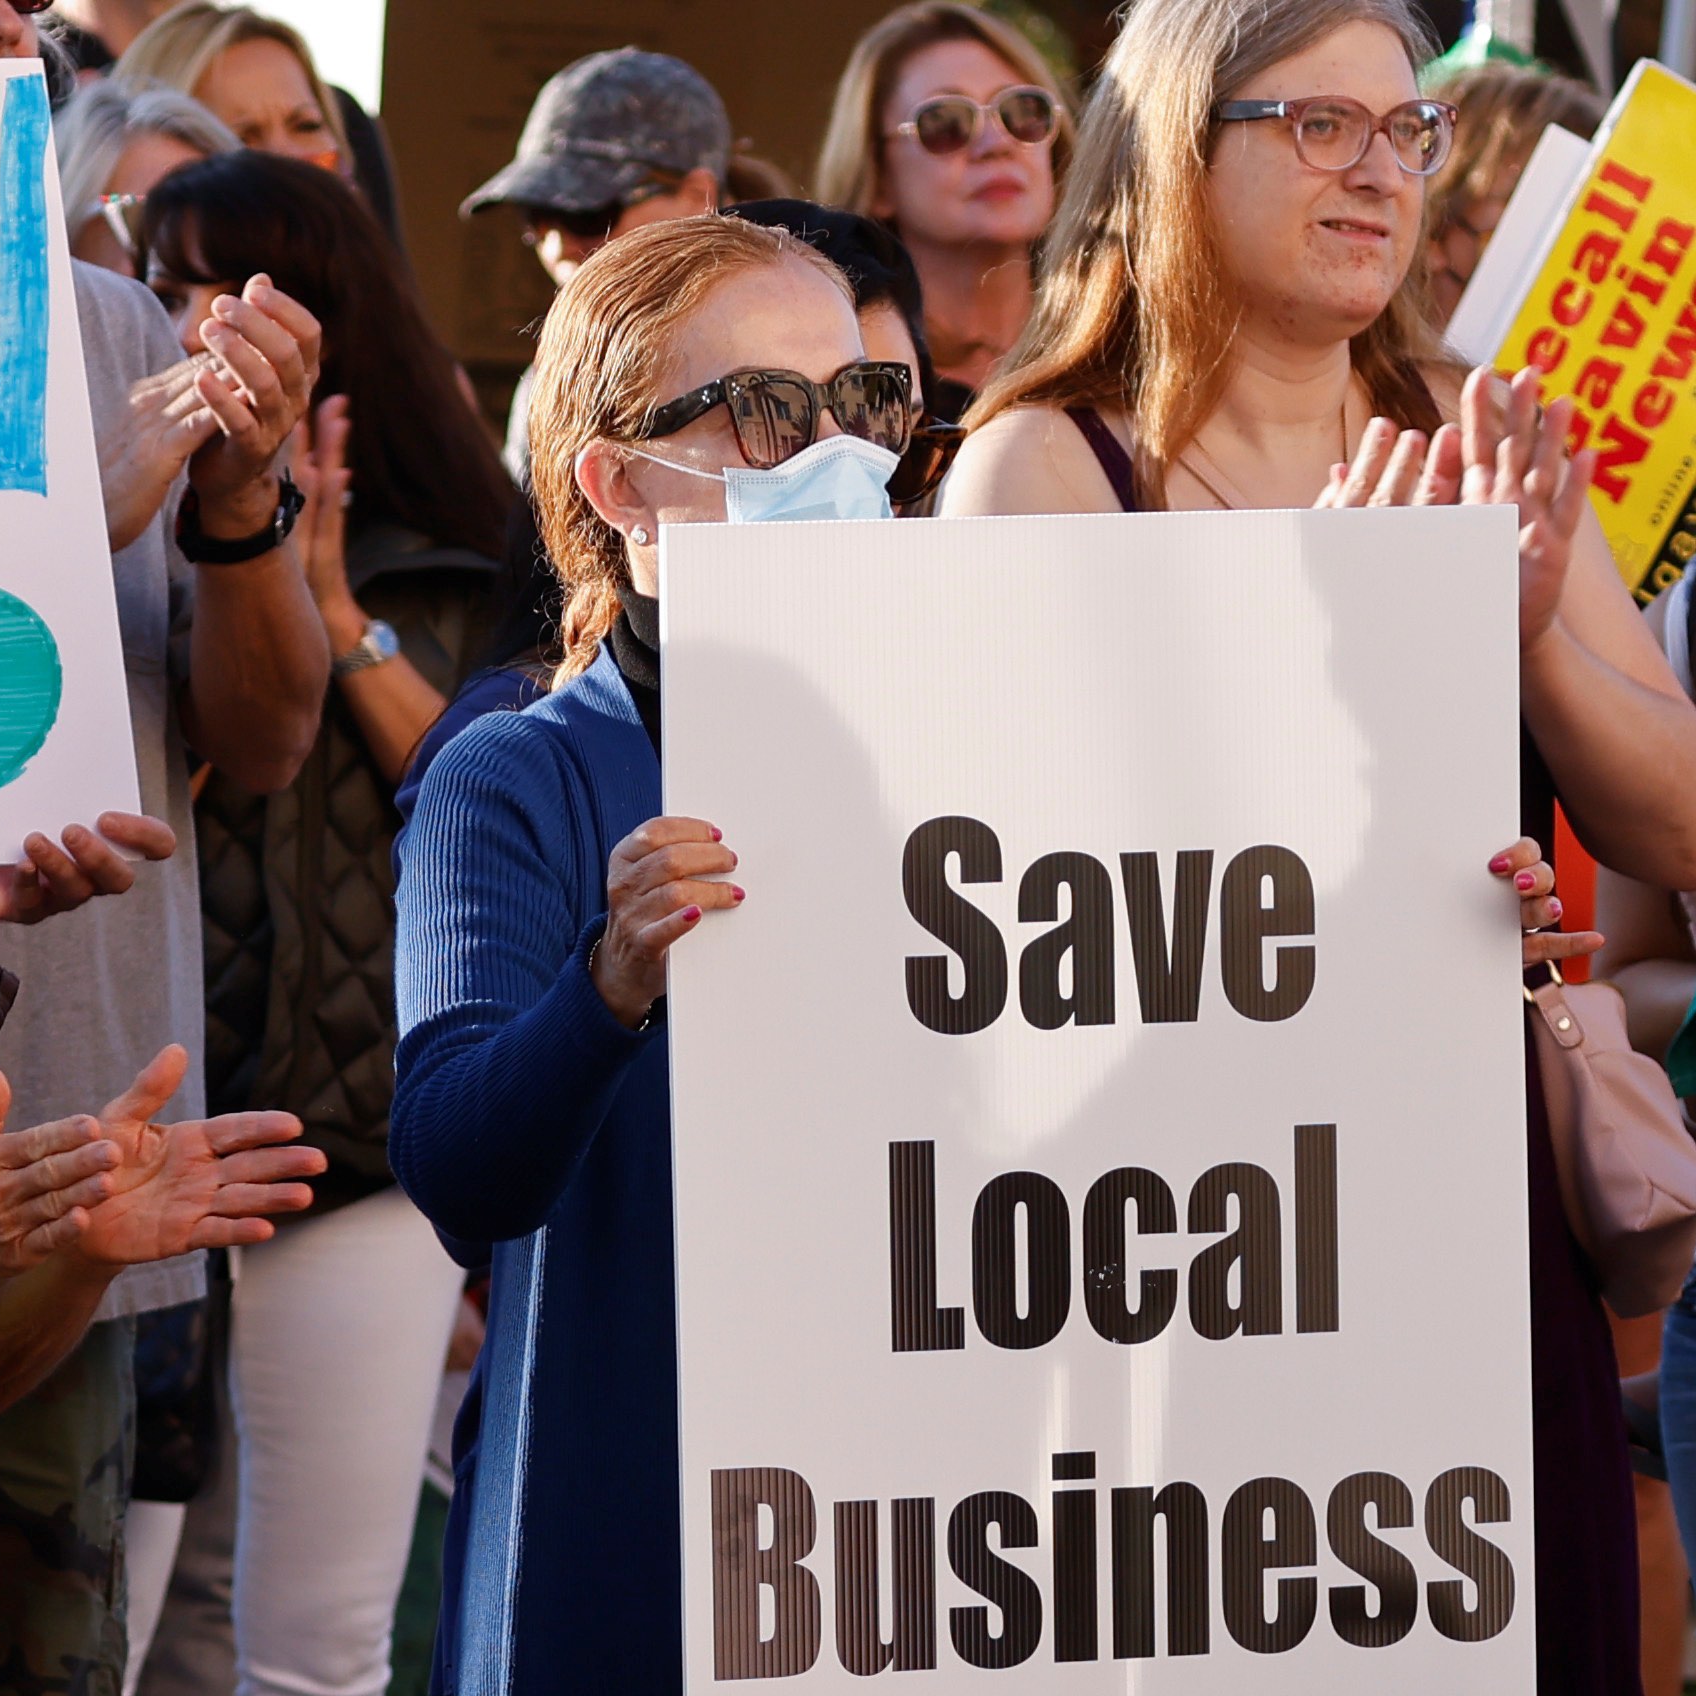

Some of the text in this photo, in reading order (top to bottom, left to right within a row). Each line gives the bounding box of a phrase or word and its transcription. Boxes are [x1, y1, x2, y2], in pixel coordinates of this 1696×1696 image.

[1500, 159, 1654, 401] ecall
[1651, 454, 1695, 528] online
[902, 815, 1316, 1035] Save
[888, 1123, 1340, 1353] Local
[710, 1451, 1516, 1681] Business
